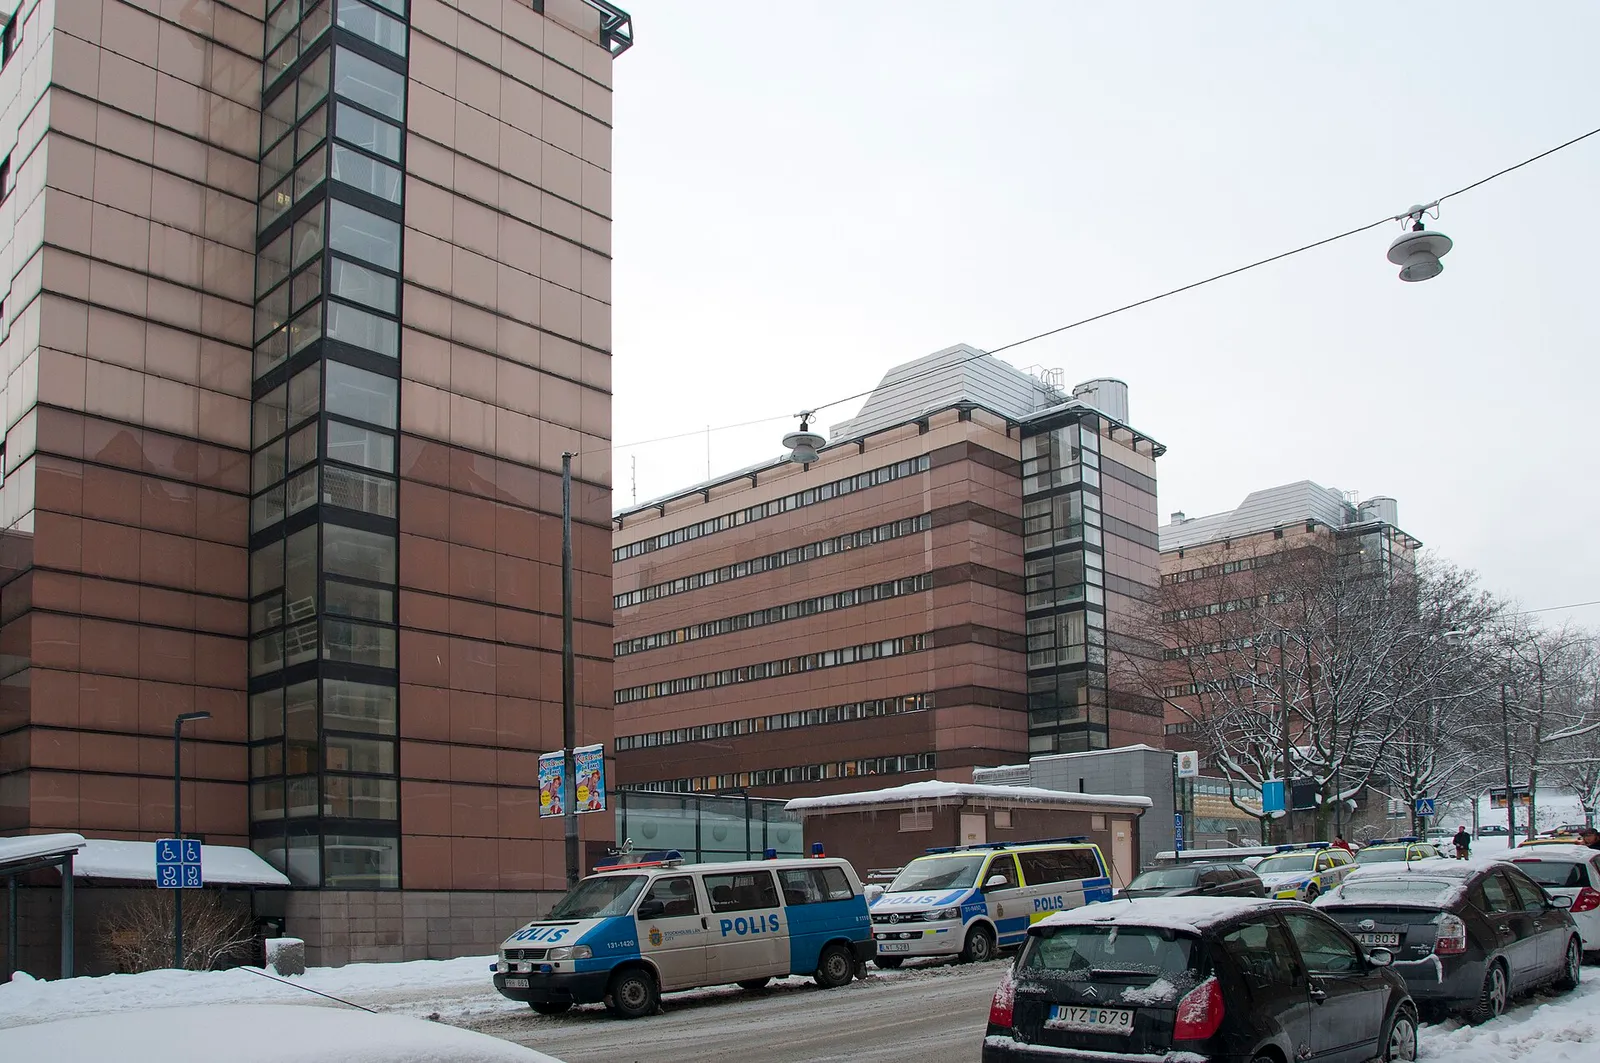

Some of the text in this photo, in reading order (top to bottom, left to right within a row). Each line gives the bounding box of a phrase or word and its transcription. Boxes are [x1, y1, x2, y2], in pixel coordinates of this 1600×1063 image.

[877, 896, 936, 906] POLIS
[1033, 896, 1064, 911] POLIS
[720, 914, 780, 937] POLIS
[506, 928, 570, 942] POLIS
[1374, 934, 1397, 944] 803
[607, 940, 634, 949] 131-1420
[1059, 1007, 1129, 1026] UYZ 679
